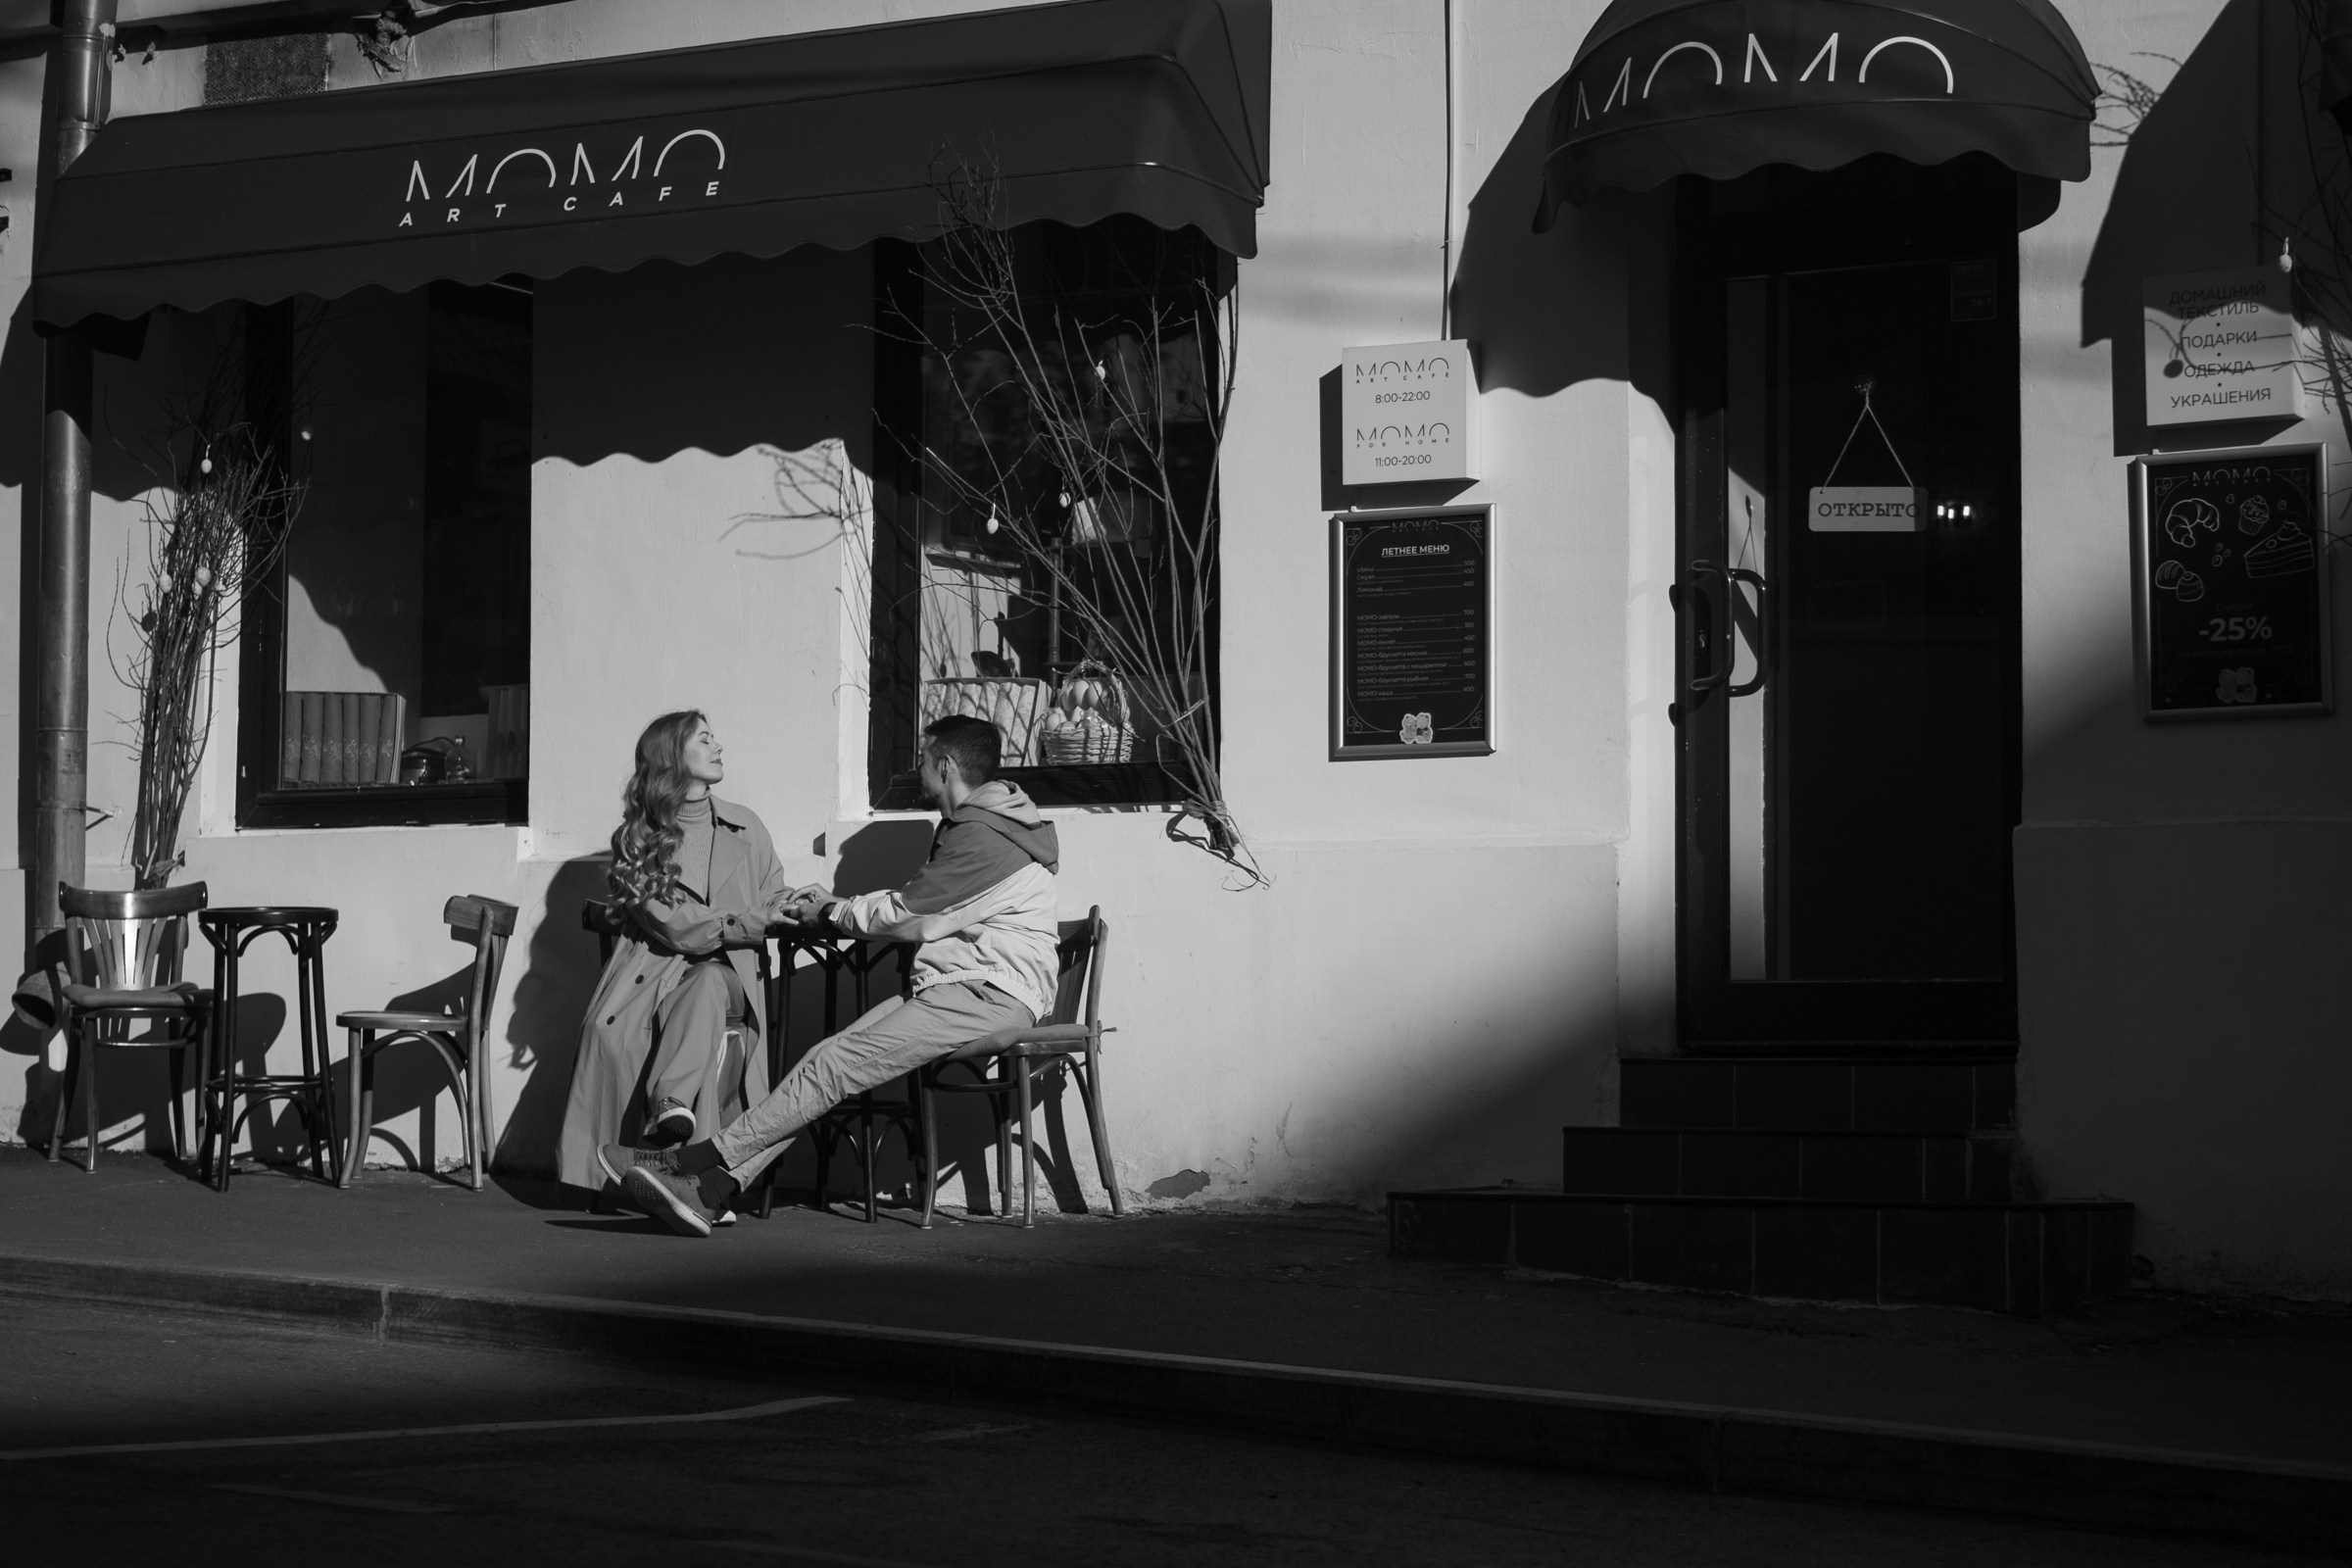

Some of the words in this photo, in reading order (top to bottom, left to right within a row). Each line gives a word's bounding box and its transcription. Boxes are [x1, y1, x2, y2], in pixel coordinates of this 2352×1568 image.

[1574, 31, 1954, 128] MOMO
[405, 128, 726, 202] MOMO
[398, 203, 507, 227] ART
[563, 180, 719, 212] CAFE
[2169, 280, 2266, 306] ДОМАШНИЙ
[2178, 301, 2259, 319] ТЕКСТИЛЬ
[2180, 330, 2258, 349] ПОДАРКИ
[1355, 357, 1449, 376] MOMO
[2183, 360, 2255, 378] ОДЕЖДА
[1402, 372, 1449, 381] CAFE
[1375, 390, 1431, 404] 8:00-22:00
[2170, 387, 2272, 409] УКРАШЕНИЯ
[1356, 422, 1449, 441] MOMO
[1404, 437, 1449, 446] HOME
[1374, 454, 1432, 467] 11:00-20:00
[2191, 466, 2271, 481] MOMO
[1818, 503, 1921, 517] ОТКРЫТО
[1392, 519, 1439, 529] MOMO
[1381, 546, 1418, 557] ЛЕТНЕЕ
[1419, 544, 1450, 555] МЕНЮ
[2198, 615, 2273, 642] -25%
